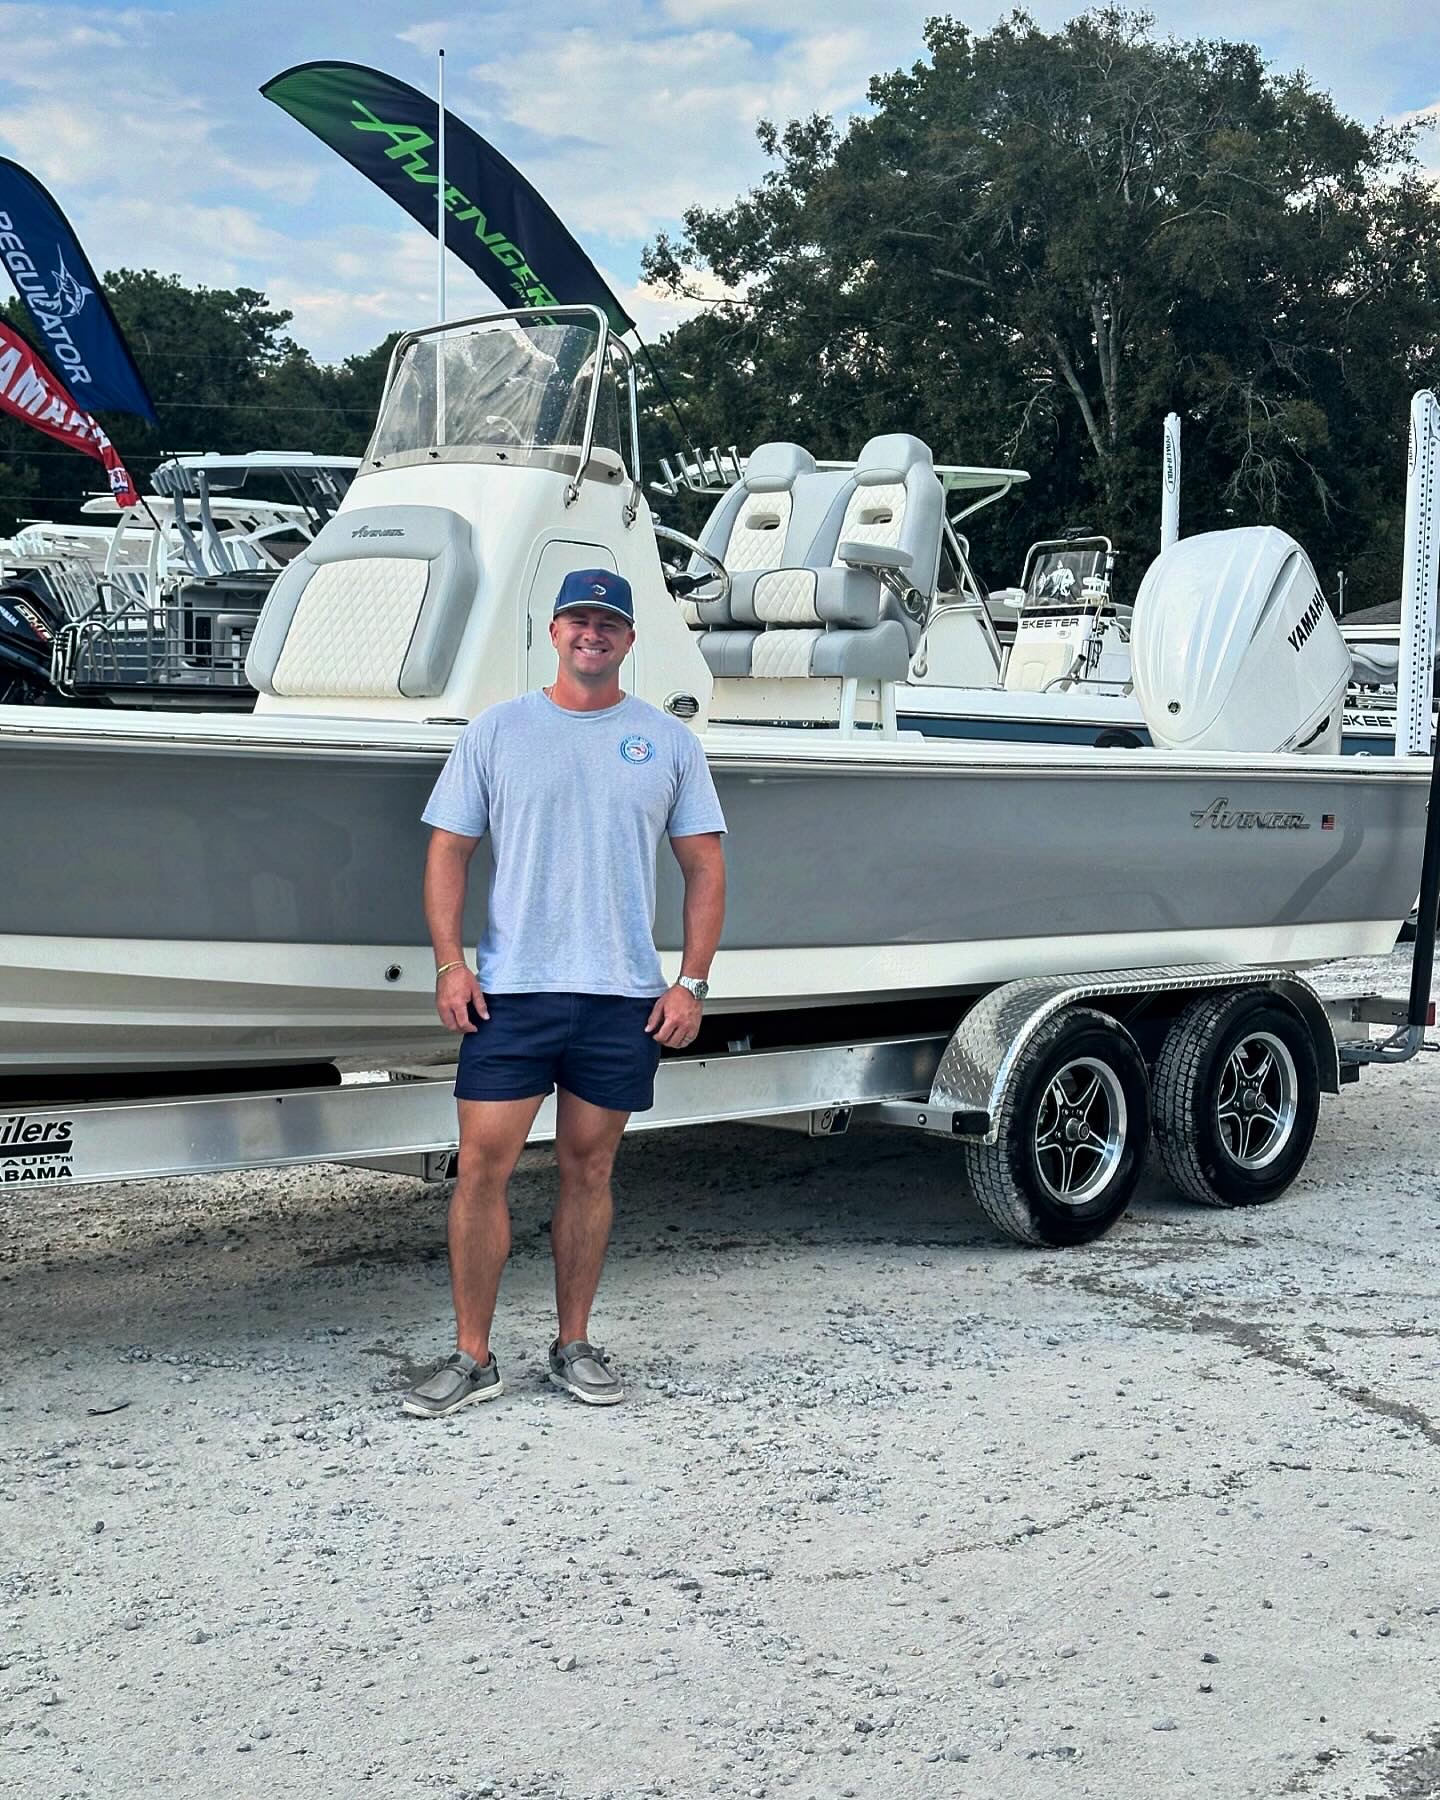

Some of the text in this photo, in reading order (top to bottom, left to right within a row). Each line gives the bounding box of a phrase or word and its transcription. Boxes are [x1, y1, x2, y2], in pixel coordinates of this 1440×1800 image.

[351, 99, 561, 325] AVENGER
[1021, 617, 1080, 630] SKEETER
[1342, 714, 1398, 728] SKEE
[0, 1116, 73, 1144] ilers
[0, 1165, 73, 1183] BAMA
